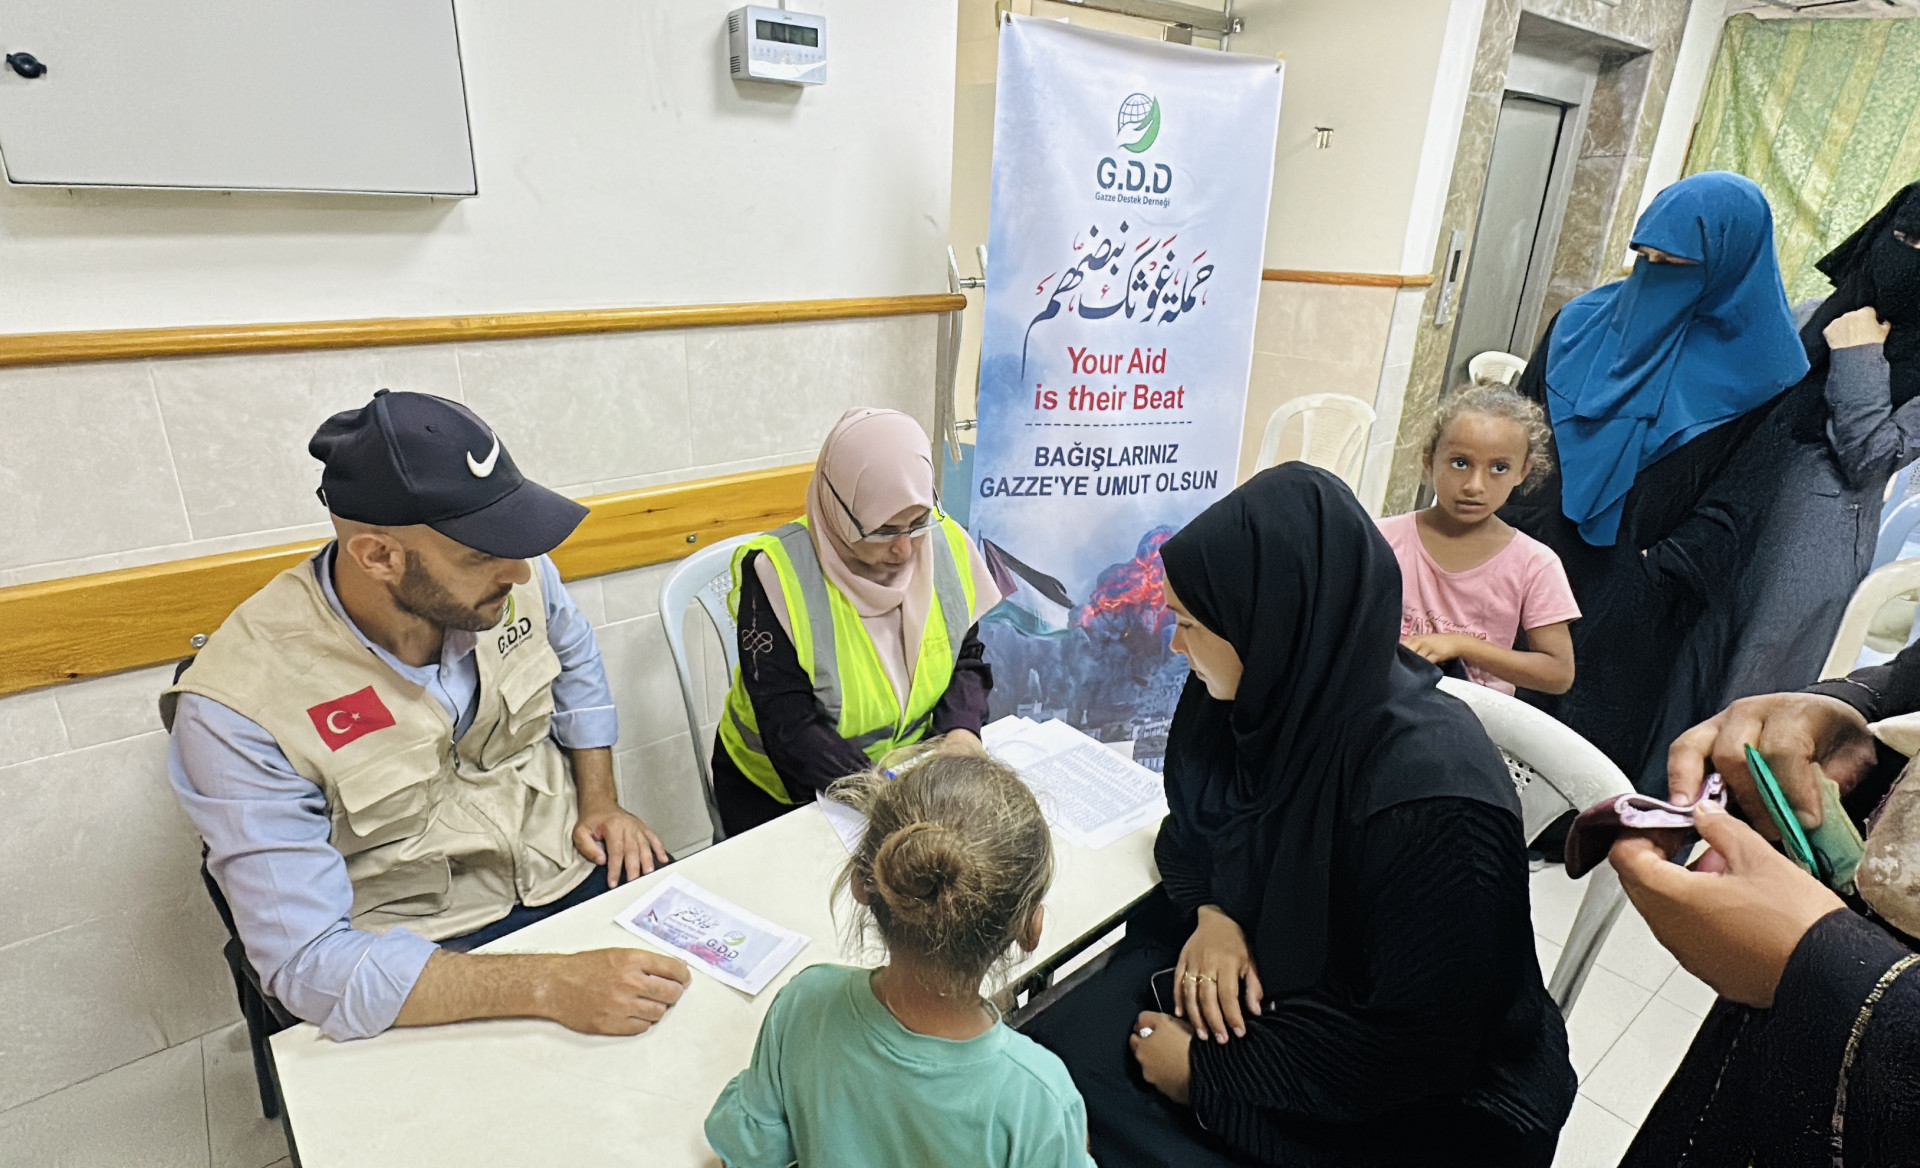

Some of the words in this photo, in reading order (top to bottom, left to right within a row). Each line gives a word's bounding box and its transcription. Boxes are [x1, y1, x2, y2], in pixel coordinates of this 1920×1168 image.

[1097, 157, 1172, 194] G.D.D
[1095, 191, 1116, 202] Gazze
[1117, 193, 1141, 204] Destek
[1143, 196, 1170, 208] Derneği
[1067, 347, 1123, 374] Your
[1127, 348, 1167, 374] Aid
[1034, 384, 1058, 410] is
[1069, 385, 1127, 411] their
[1133, 384, 1185, 410] Beat
[1034, 442, 1179, 471] BAĞIŞLARINIZ
[980, 476, 1089, 498] GAZZE'YE
[1096, 474, 1150, 496] UMUT
[1155, 470, 1218, 492] OLSUN
[498, 617, 532, 654] G.D.D
[706, 938, 739, 959] G.D.D
